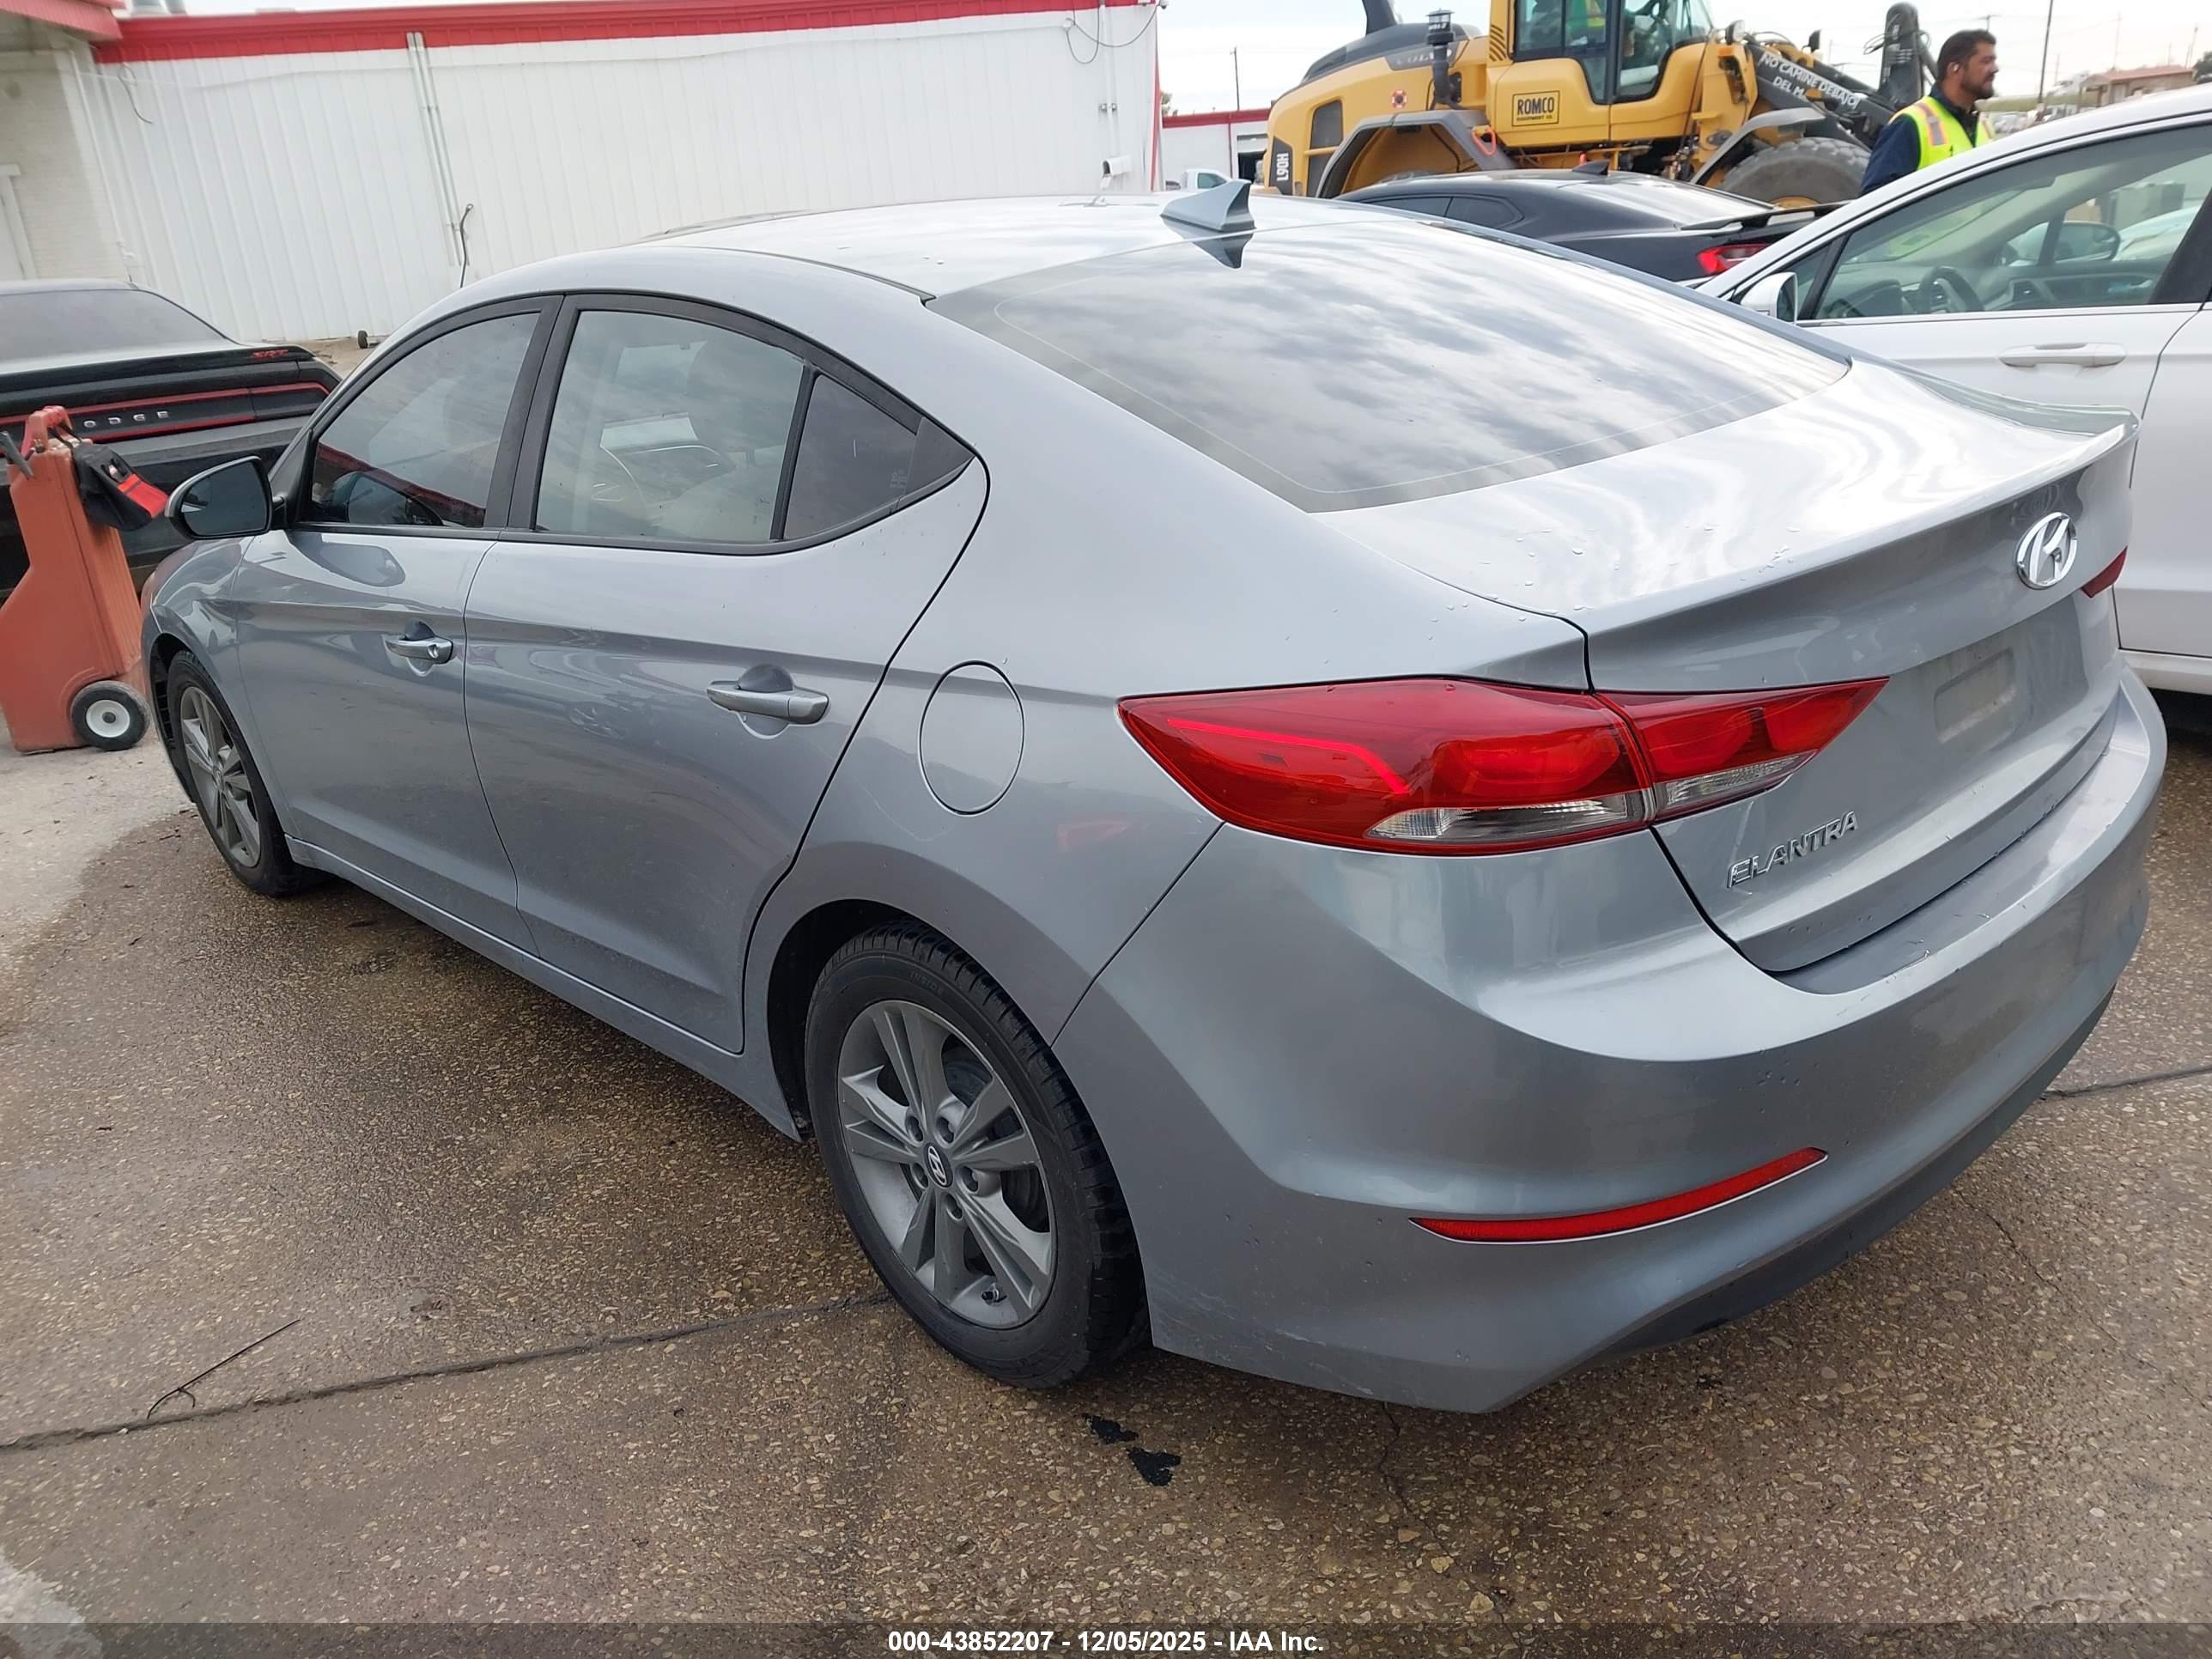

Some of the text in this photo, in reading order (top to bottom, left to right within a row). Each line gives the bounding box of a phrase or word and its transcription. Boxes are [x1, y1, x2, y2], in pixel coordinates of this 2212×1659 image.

[1760, 52, 1778, 68] NO
[1779, 63, 1819, 88] CAMINE
[1772, 76, 1792, 92] DEL
[1517, 97, 1554, 115] ROMCO
[1276, 152, 1290, 181] L90H
[1727, 811, 1858, 888] ELANTRA
